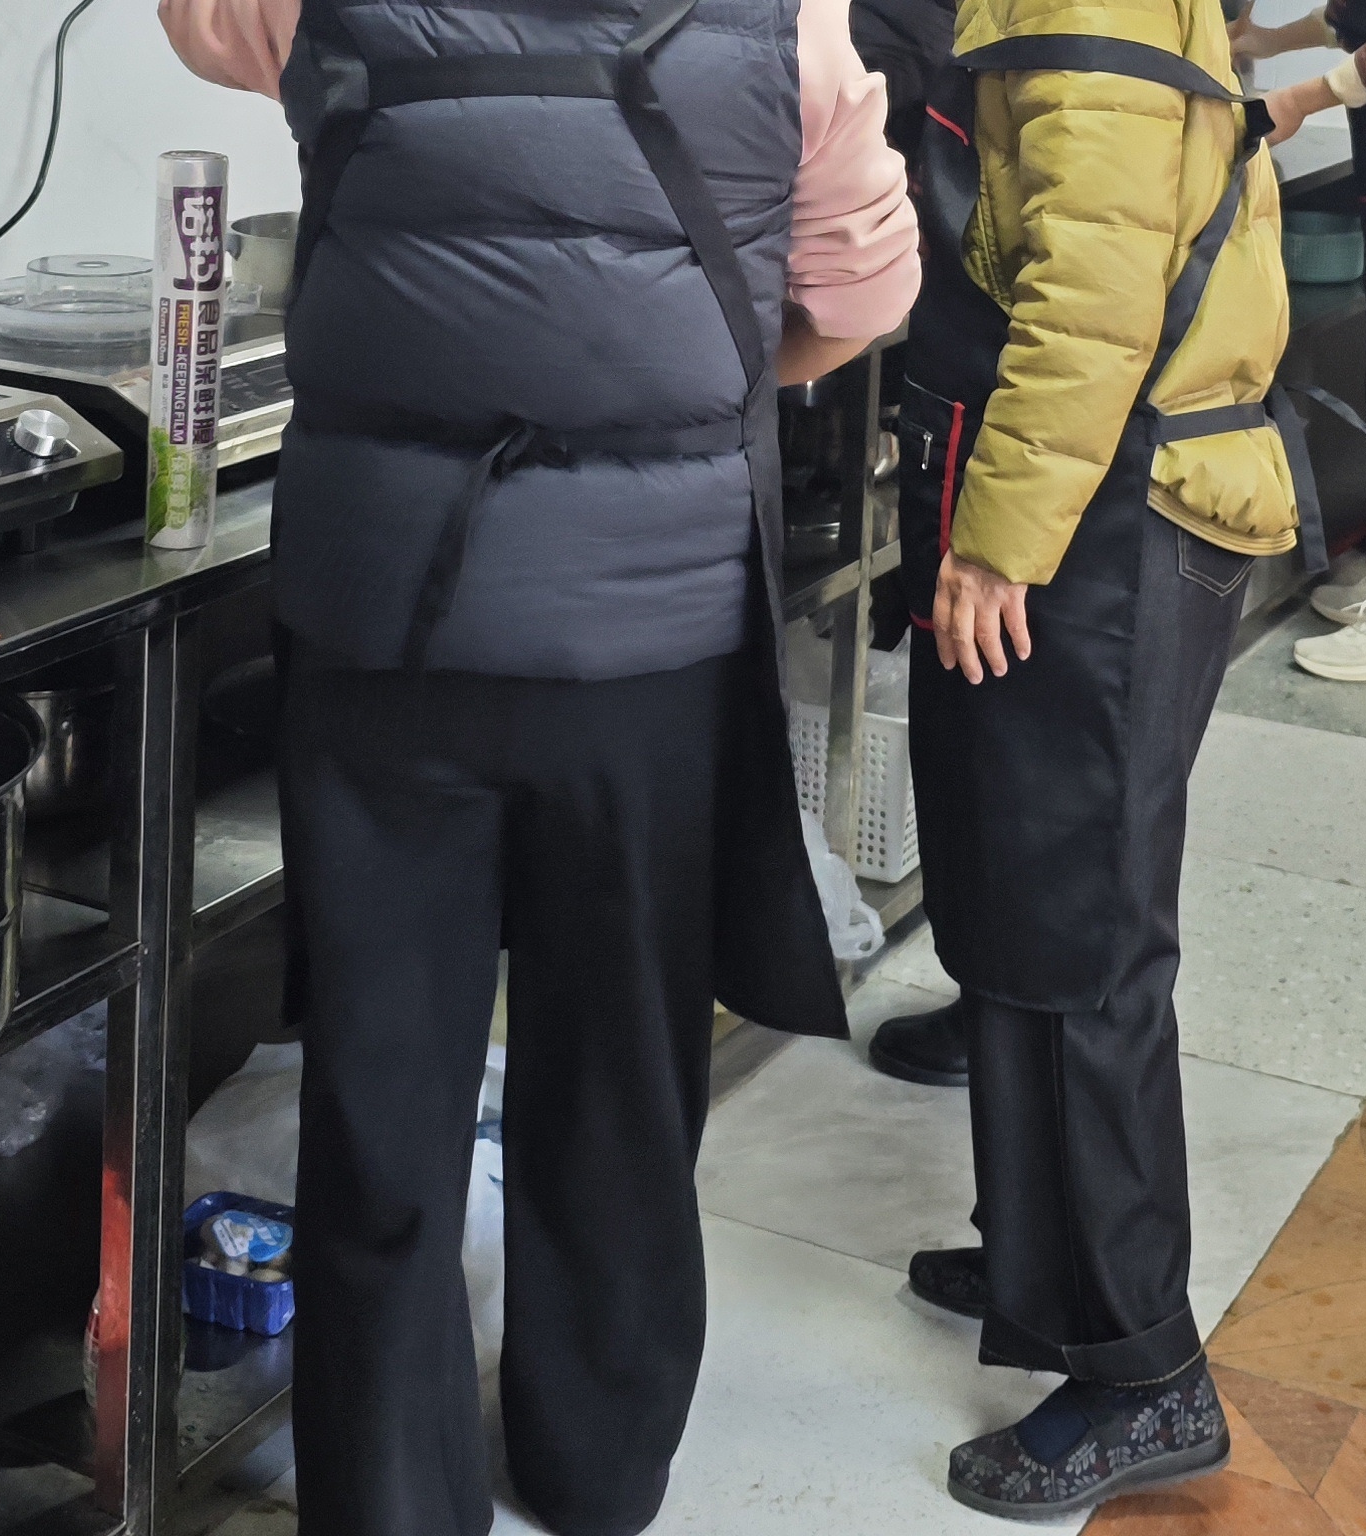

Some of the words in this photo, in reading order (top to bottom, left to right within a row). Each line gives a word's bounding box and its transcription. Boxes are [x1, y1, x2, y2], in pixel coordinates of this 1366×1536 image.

[173, 303, 190, 412] FRESH-KEEPING
[192, 300, 220, 445] 食品保鲜膜
[172, 411, 187, 443] FILM
